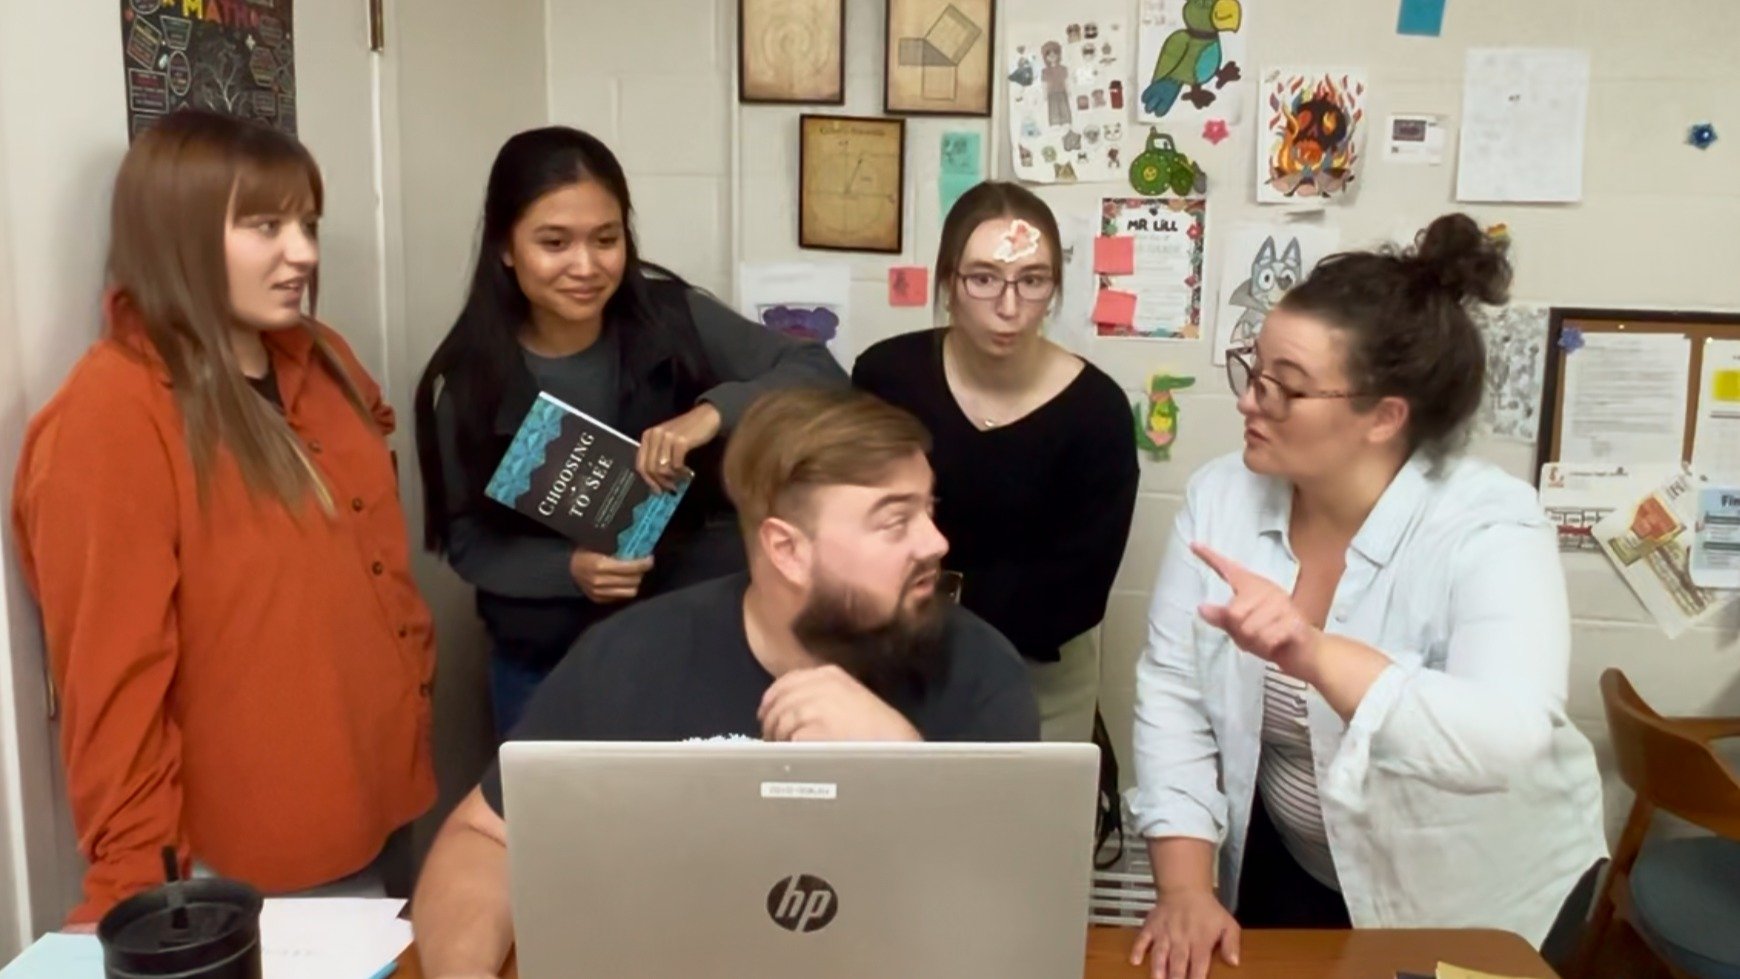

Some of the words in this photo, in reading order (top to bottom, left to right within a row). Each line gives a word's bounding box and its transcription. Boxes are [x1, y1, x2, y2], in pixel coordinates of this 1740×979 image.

[1127, 219, 1149, 231] MR
[537, 431, 595, 517] CHOOSING
[569, 494, 591, 517] TO
[585, 455, 614, 490] SEE
[773, 873, 832, 932] hp
